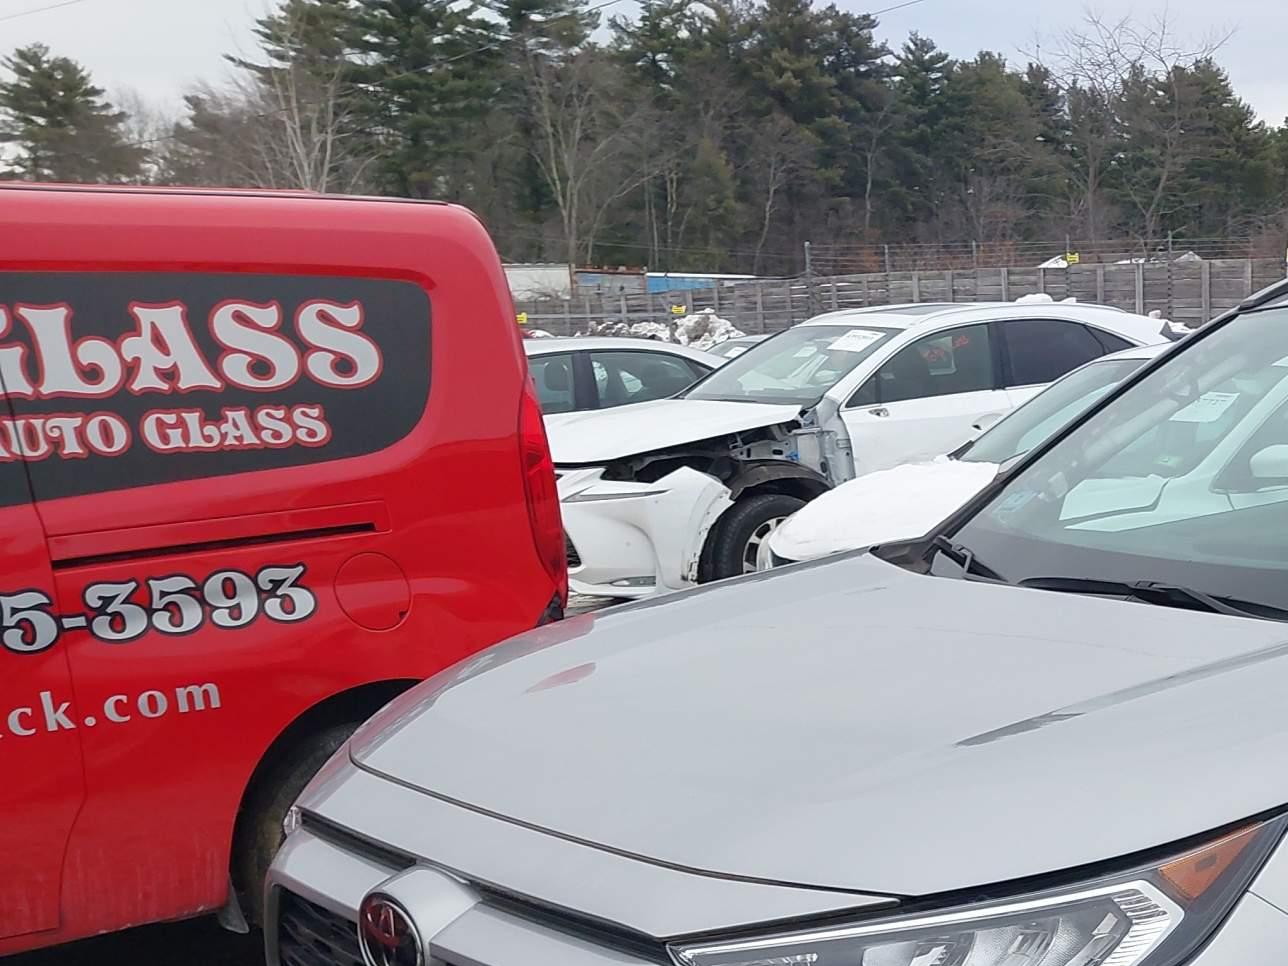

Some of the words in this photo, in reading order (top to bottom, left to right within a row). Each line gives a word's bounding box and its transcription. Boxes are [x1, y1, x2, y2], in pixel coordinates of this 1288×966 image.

[0, 413, 130, 461] UTO
[141, 404, 332, 452] GLASS
[0, 562, 317, 653] 5-3593
[0, 681, 222, 738] ck.com
